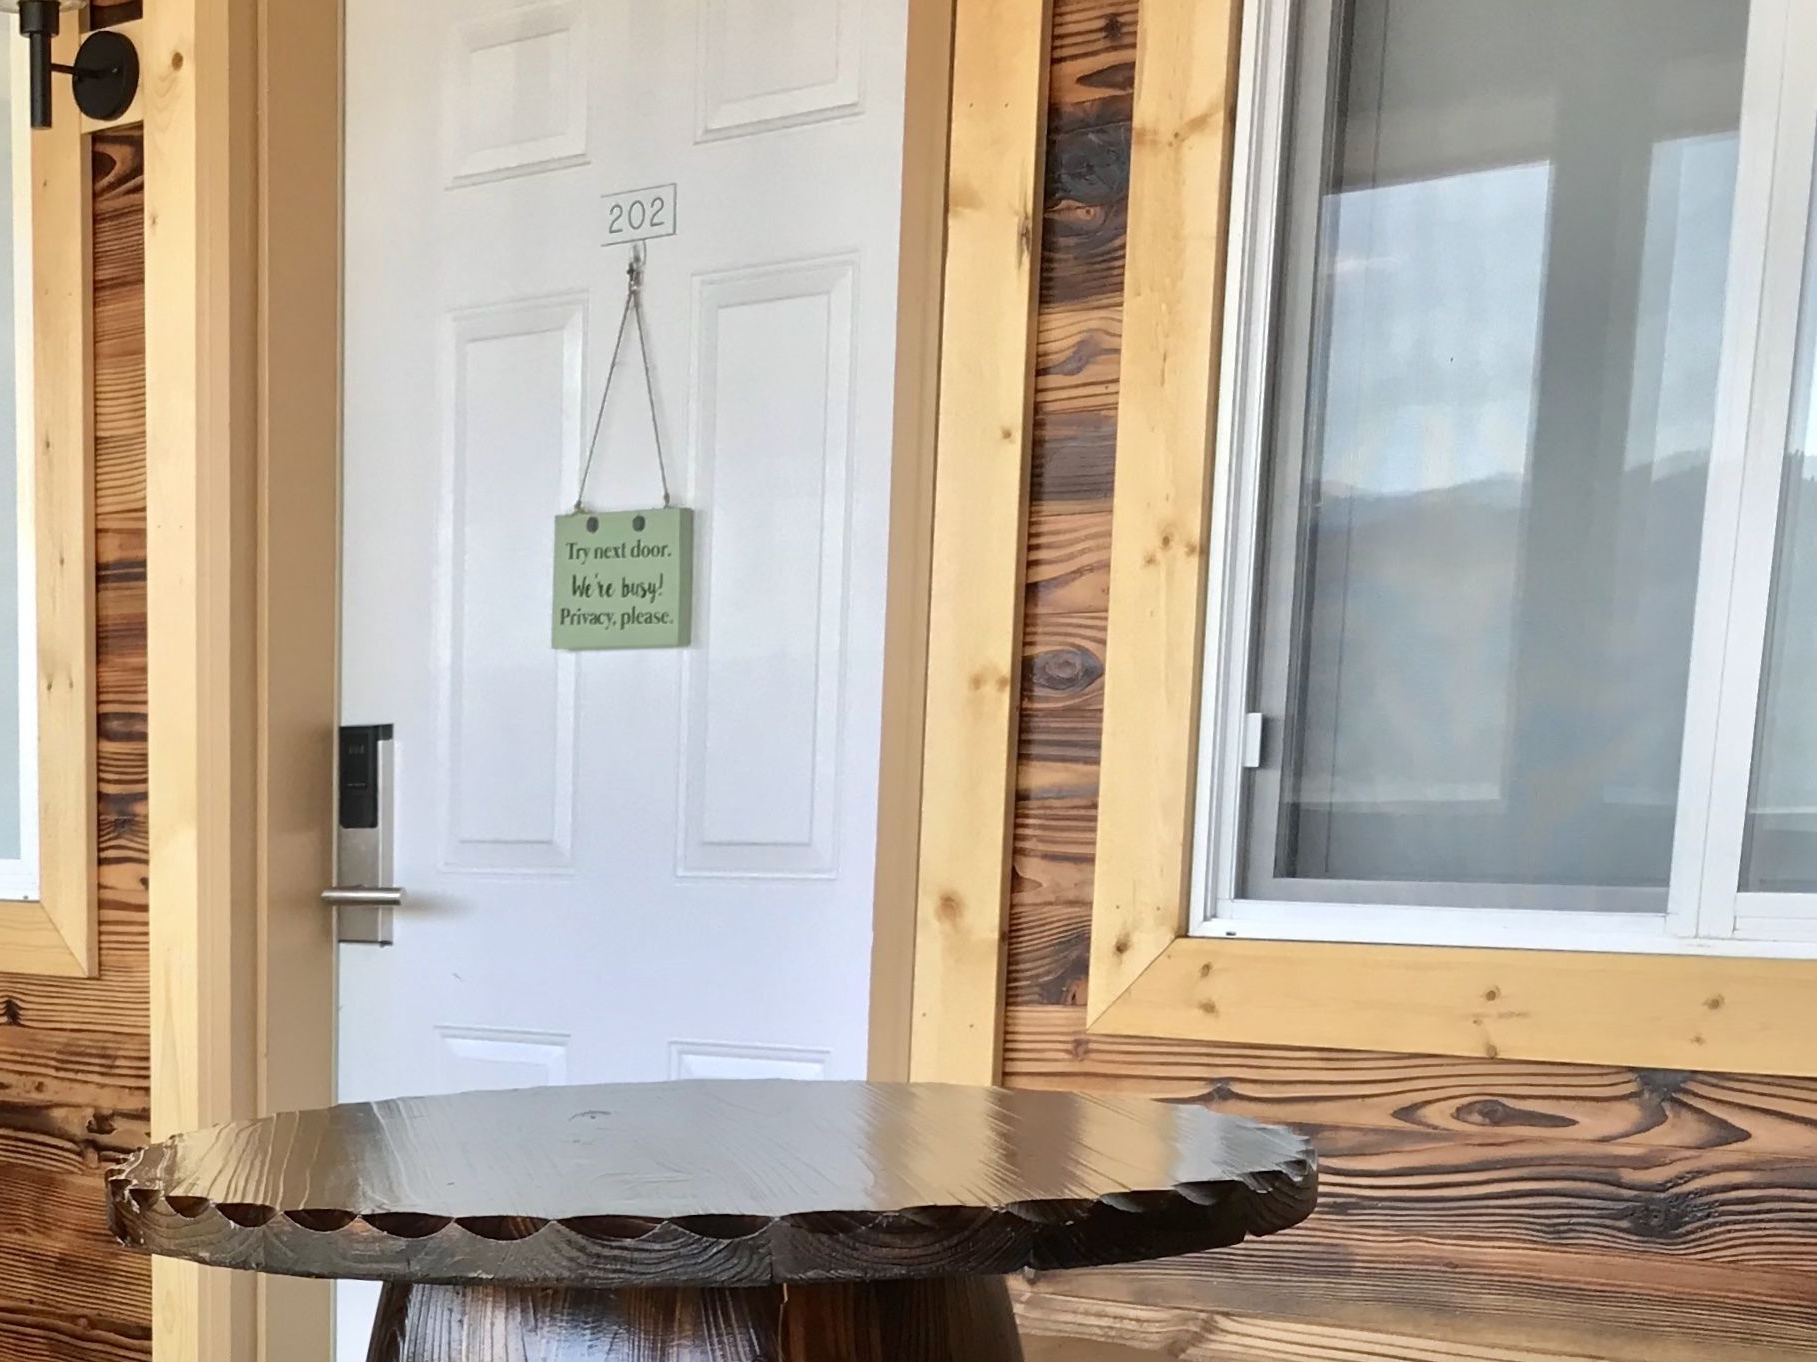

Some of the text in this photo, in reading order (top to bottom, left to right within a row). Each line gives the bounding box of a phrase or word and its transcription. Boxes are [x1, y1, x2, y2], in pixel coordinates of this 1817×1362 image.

[609, 197, 665, 234] 202
[566, 539, 672, 565] Try next door.
[572, 573, 663, 603] We're busy!
[620, 606, 674, 630] please.
